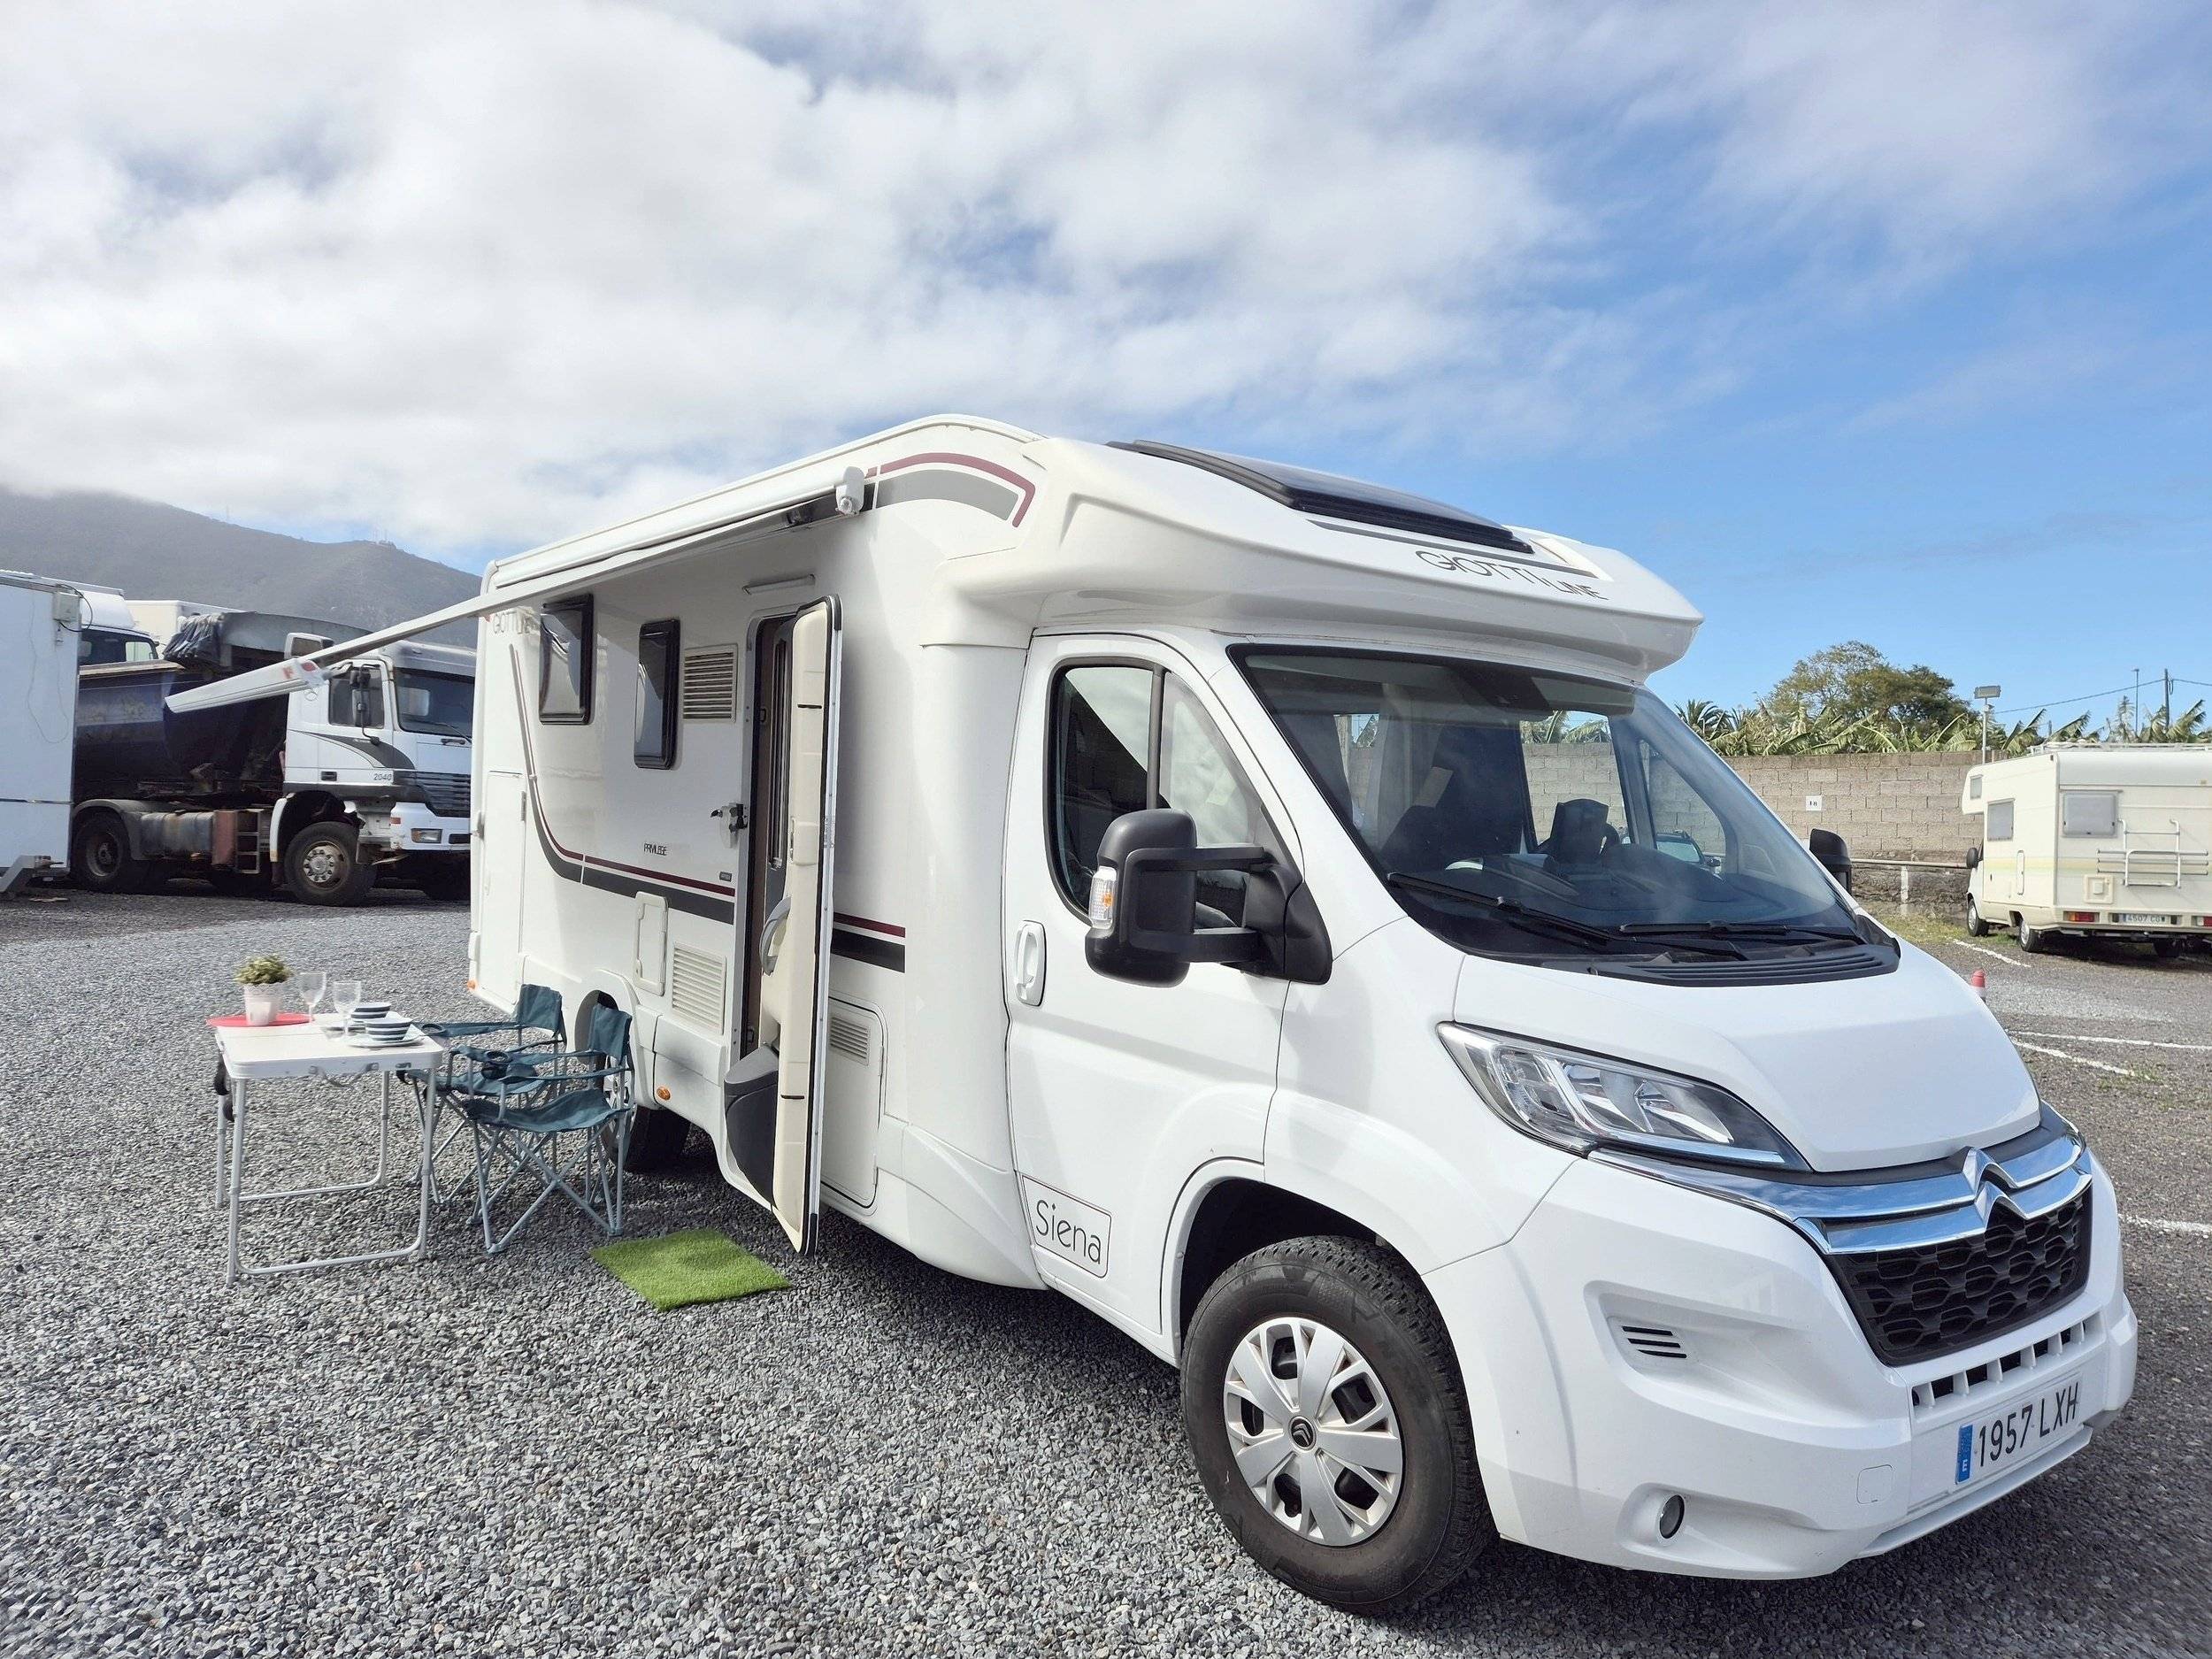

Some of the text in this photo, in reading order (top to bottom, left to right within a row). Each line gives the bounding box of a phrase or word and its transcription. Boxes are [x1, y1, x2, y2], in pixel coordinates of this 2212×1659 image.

[1036, 1199, 1101, 1264] Siena
[1962, 1381, 2078, 1471] E 1957 LXH
